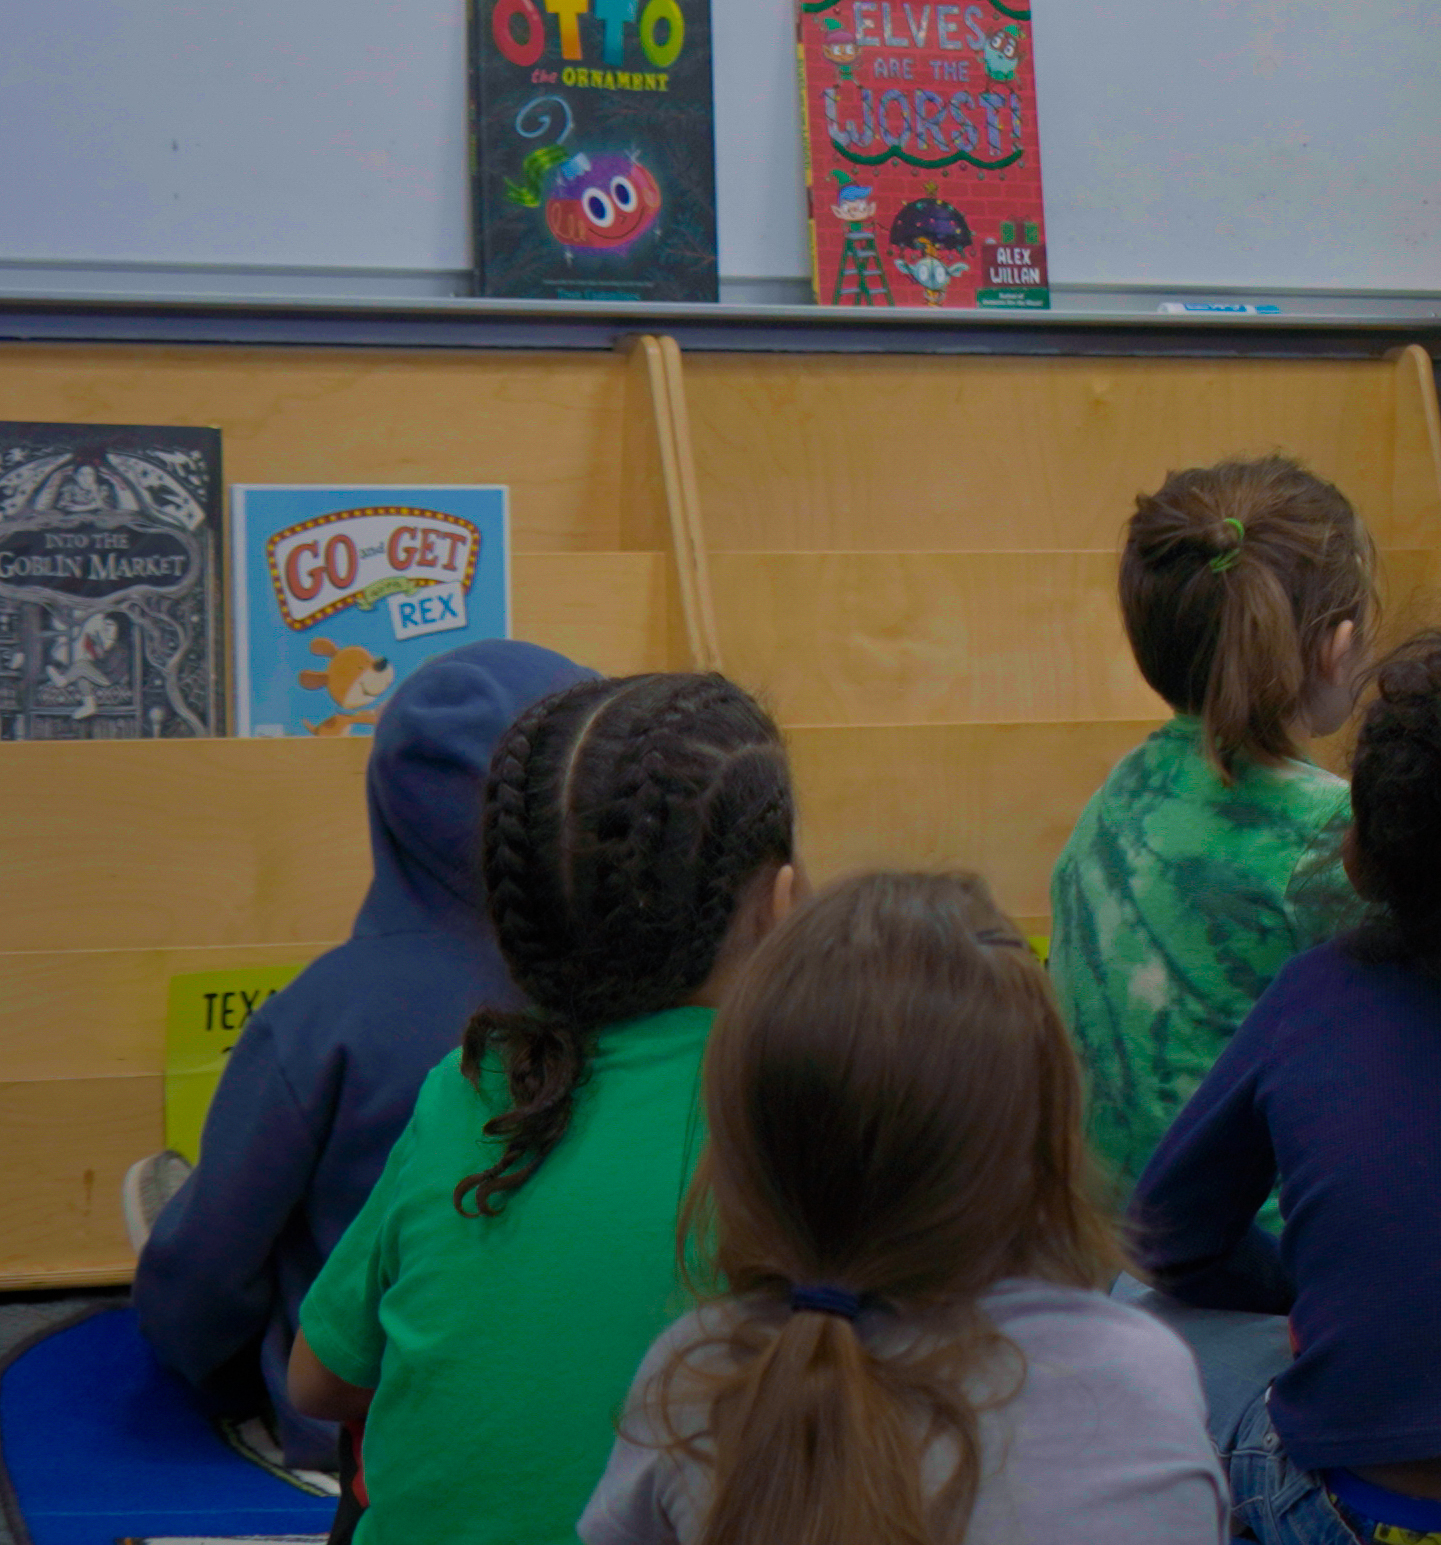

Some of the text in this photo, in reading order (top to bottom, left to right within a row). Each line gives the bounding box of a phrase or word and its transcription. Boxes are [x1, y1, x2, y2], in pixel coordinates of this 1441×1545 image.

[853, 1, 987, 52] ELVES
[530, 67, 670, 92] the ORNAMENT
[873, 58, 971, 83] ARE THE
[821, 87, 1024, 157] WORST!
[997, 247, 1032, 265] ALEX
[989, 267, 1040, 284] WILLAN
[44, 532, 130, 552] INTO THE
[90, 553, 187, 582] MARKET
[285, 533, 359, 601] GO
[387, 526, 469, 572] GET
[399, 593, 458, 629] REX
